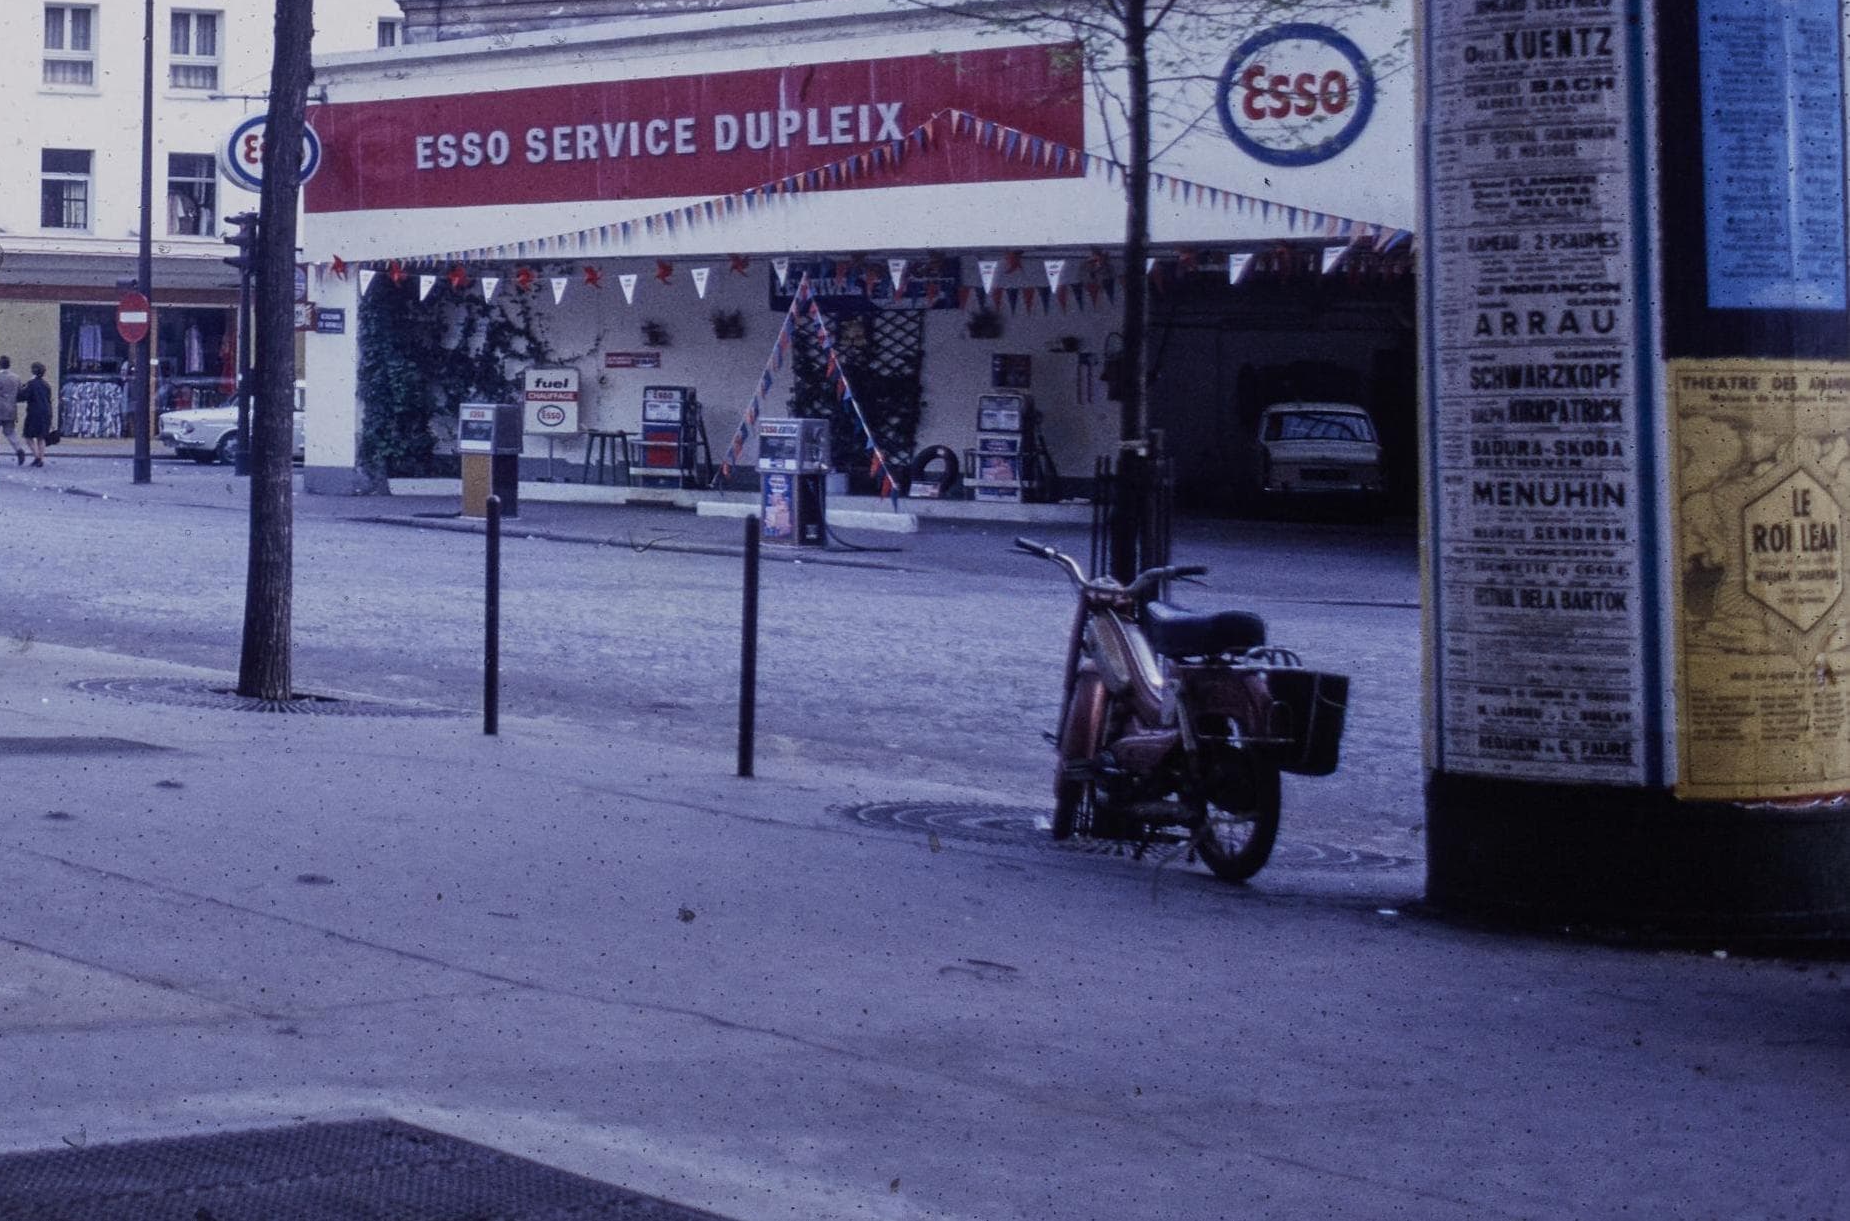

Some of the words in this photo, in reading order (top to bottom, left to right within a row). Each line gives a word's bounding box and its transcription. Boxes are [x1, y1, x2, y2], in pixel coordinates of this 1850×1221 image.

[1503, 27, 1612, 61] KUENTZ
[1530, 77, 1614, 93] BACH
[416, 130, 510, 169] ESSO
[526, 117, 695, 162] SERVICE
[715, 102, 904, 151] DUPLEIX
[1475, 310, 1616, 336] ARRAU
[535, 377, 568, 388] fuel
[1469, 364, 1621, 389] SCHWARZKOPF
[1771, 376, 1797, 390] DES
[1509, 398, 1623, 423] KIRKPATRICK
[1470, 440, 1623, 456] BADURA-SKODA
[1472, 481, 1626, 507] MENUHIN
[1792, 489, 1810, 517] LE
[1533, 526, 1627, 540] GENDRON
[1753, 524, 1791, 552] ROI
[1801, 523, 1837, 552] LEAR
[1561, 589, 1628, 611] BARTOK
